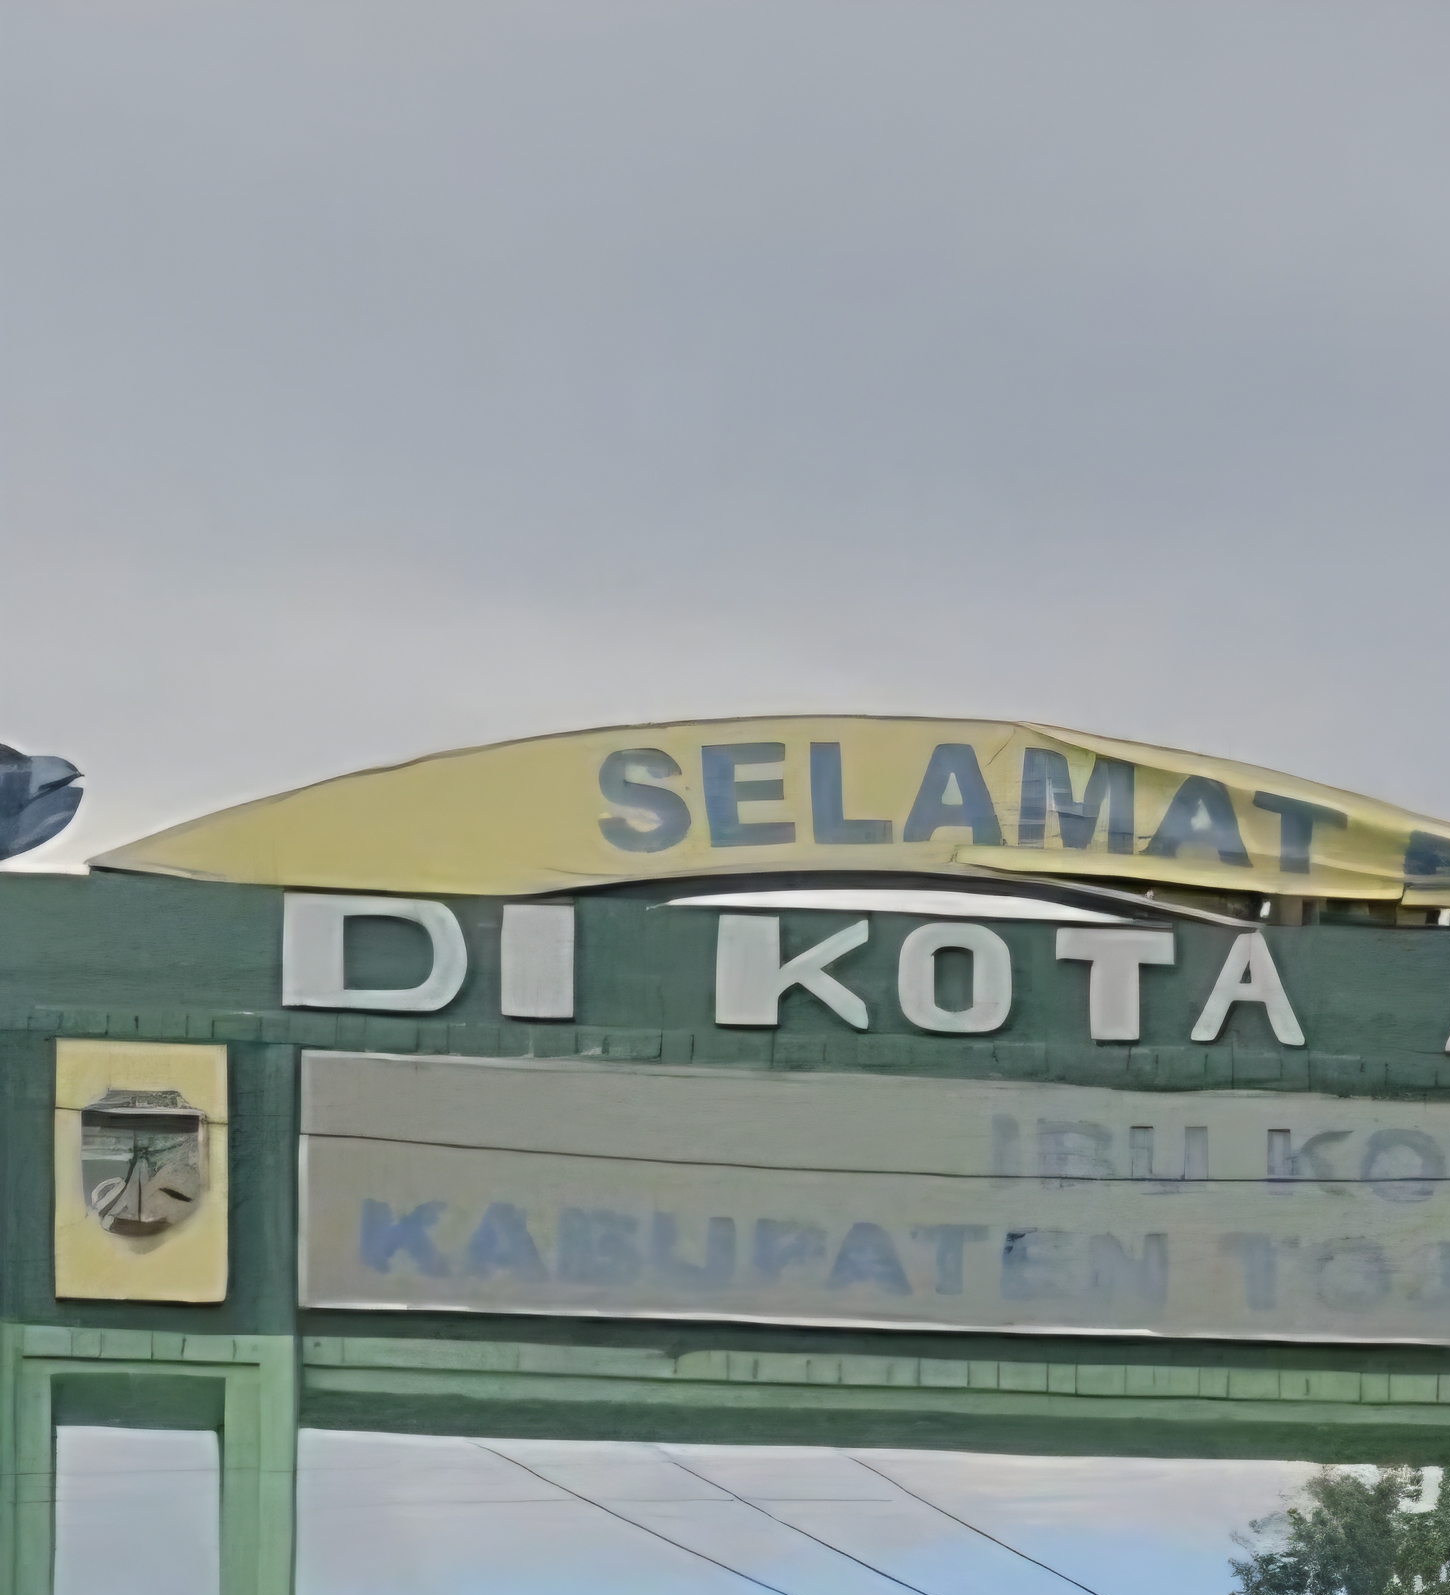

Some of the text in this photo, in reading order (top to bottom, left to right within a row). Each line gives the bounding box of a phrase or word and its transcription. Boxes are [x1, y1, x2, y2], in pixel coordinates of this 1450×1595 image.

[598, 743, 1347, 875] SELAMAT
[282, 892, 575, 1020] DI
[715, 915, 1306, 1047] KOTA
[991, 1114, 1208, 1194] IBU
[358, 1200, 1169, 1304] KABUPATEN
